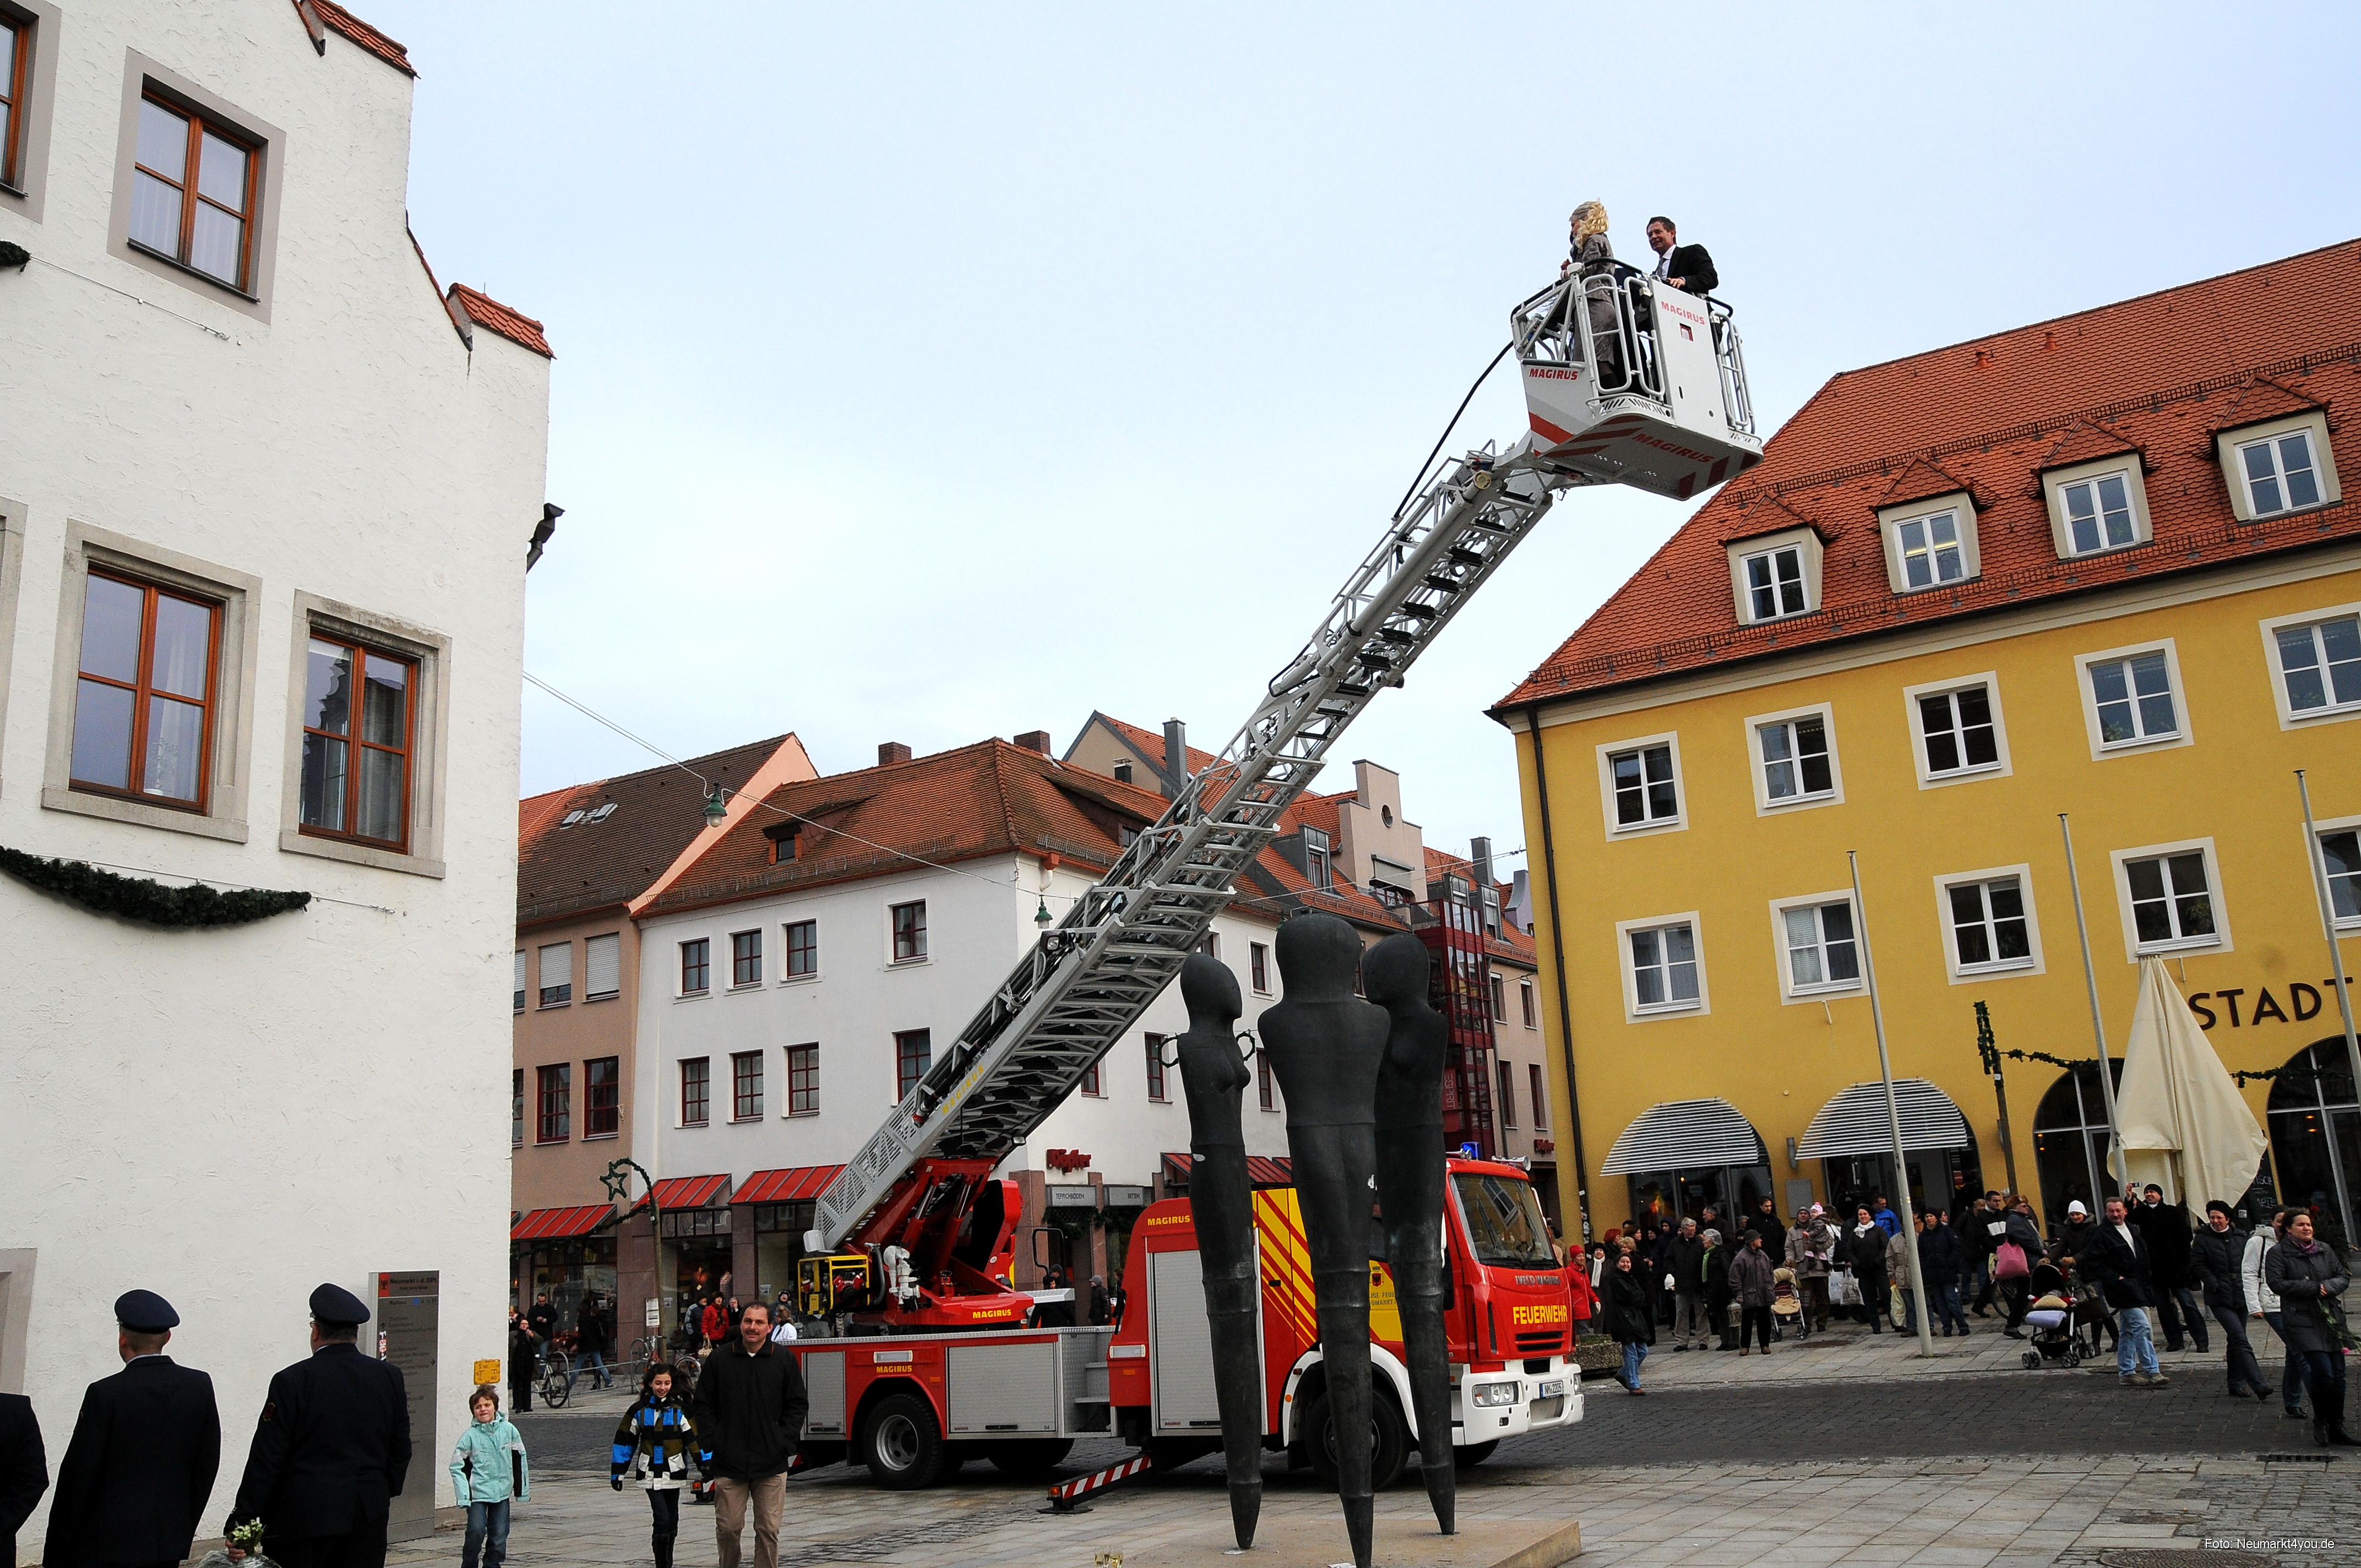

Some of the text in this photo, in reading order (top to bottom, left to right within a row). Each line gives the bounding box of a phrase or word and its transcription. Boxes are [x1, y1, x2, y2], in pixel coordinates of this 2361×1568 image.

[1661, 301, 1706, 325] MAGIRUS
[1529, 368, 1579, 380] MAGIRUS
[1633, 433, 1716, 463] MAGIRUS
[942, 1063, 984, 1116] MAGIRUS
[1444, 1072, 1455, 1109] ESPRIT
[1147, 1215, 1190, 1226] MAGIRUS
[972, 1309, 1011, 1319] MAGIRUS
[1513, 1305, 1568, 1325] FEUERWEHR
